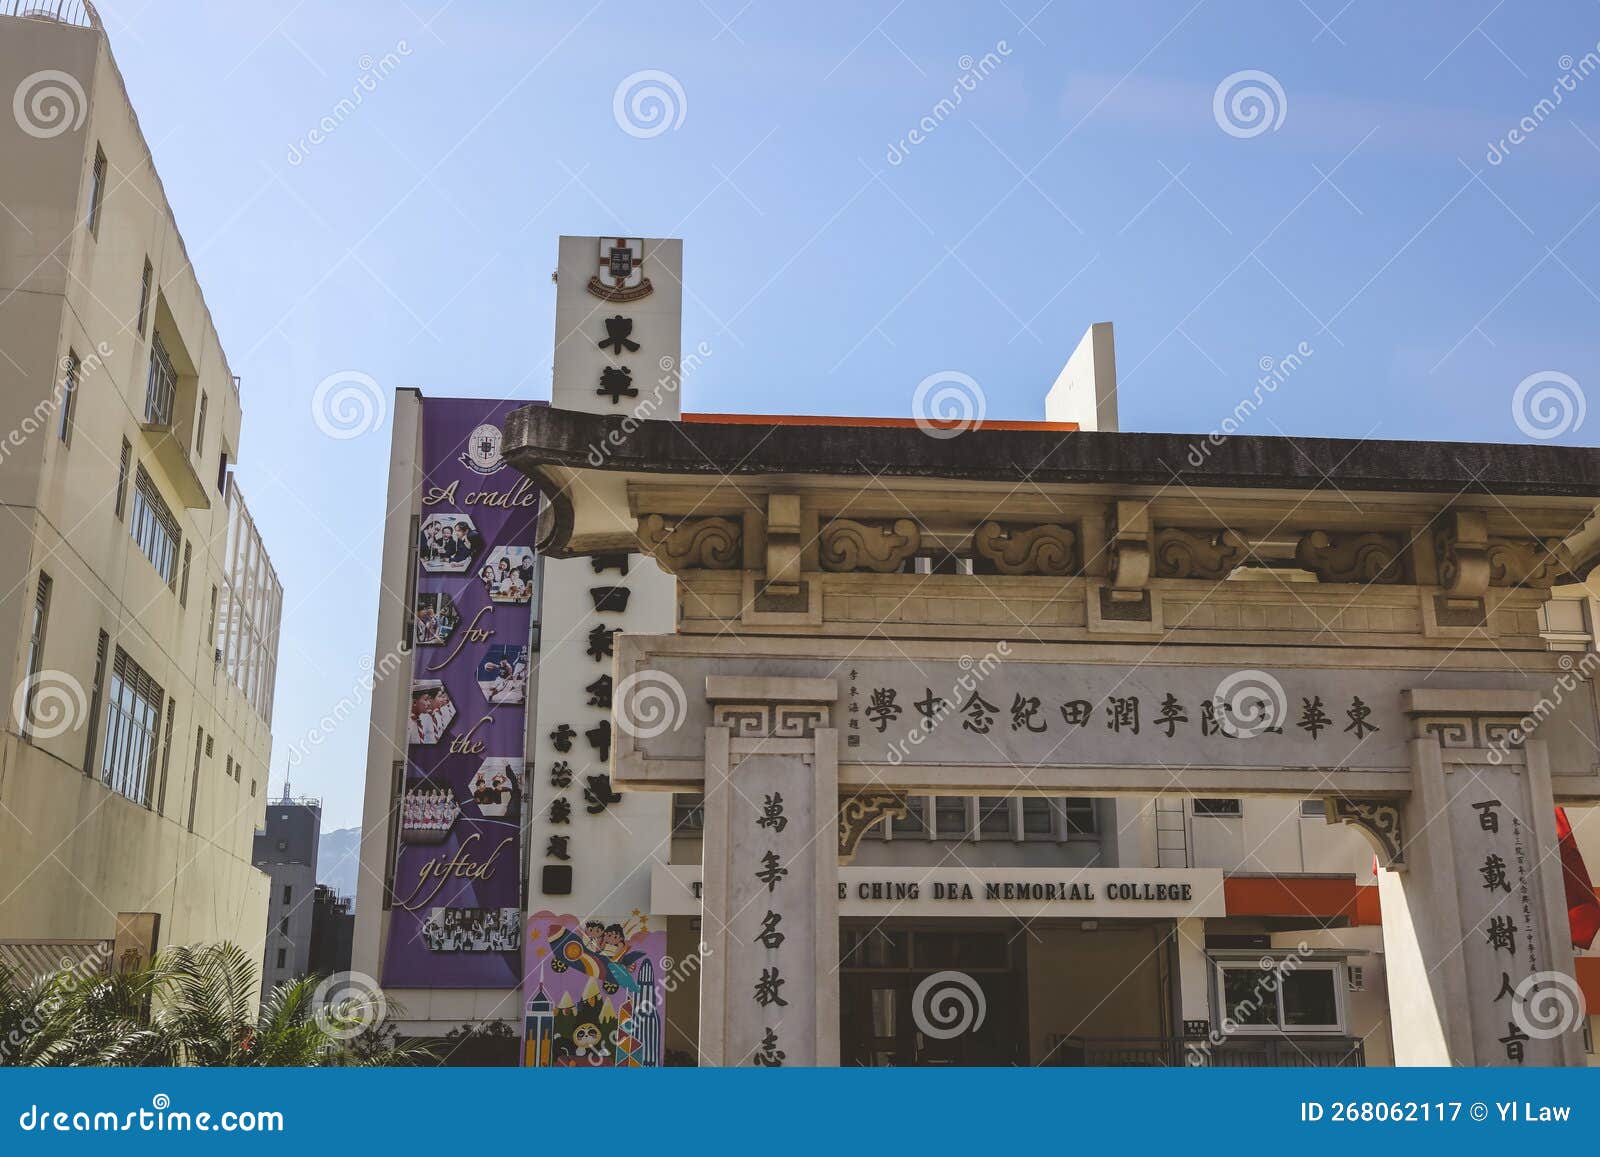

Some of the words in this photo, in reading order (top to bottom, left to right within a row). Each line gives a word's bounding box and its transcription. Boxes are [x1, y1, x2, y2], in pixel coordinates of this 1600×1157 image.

[422, 480, 460, 506] A
[464, 475, 537, 509] cradle
[426, 606, 494, 671] for
[449, 716, 493, 754] the
[392, 833, 513, 911] gifted
[858, 882, 920, 900] CHING
[933, 882, 974, 900] DEA
[985, 882, 1095, 901] MEMORIAL
[1106, 883, 1192, 901] COLLEGE
